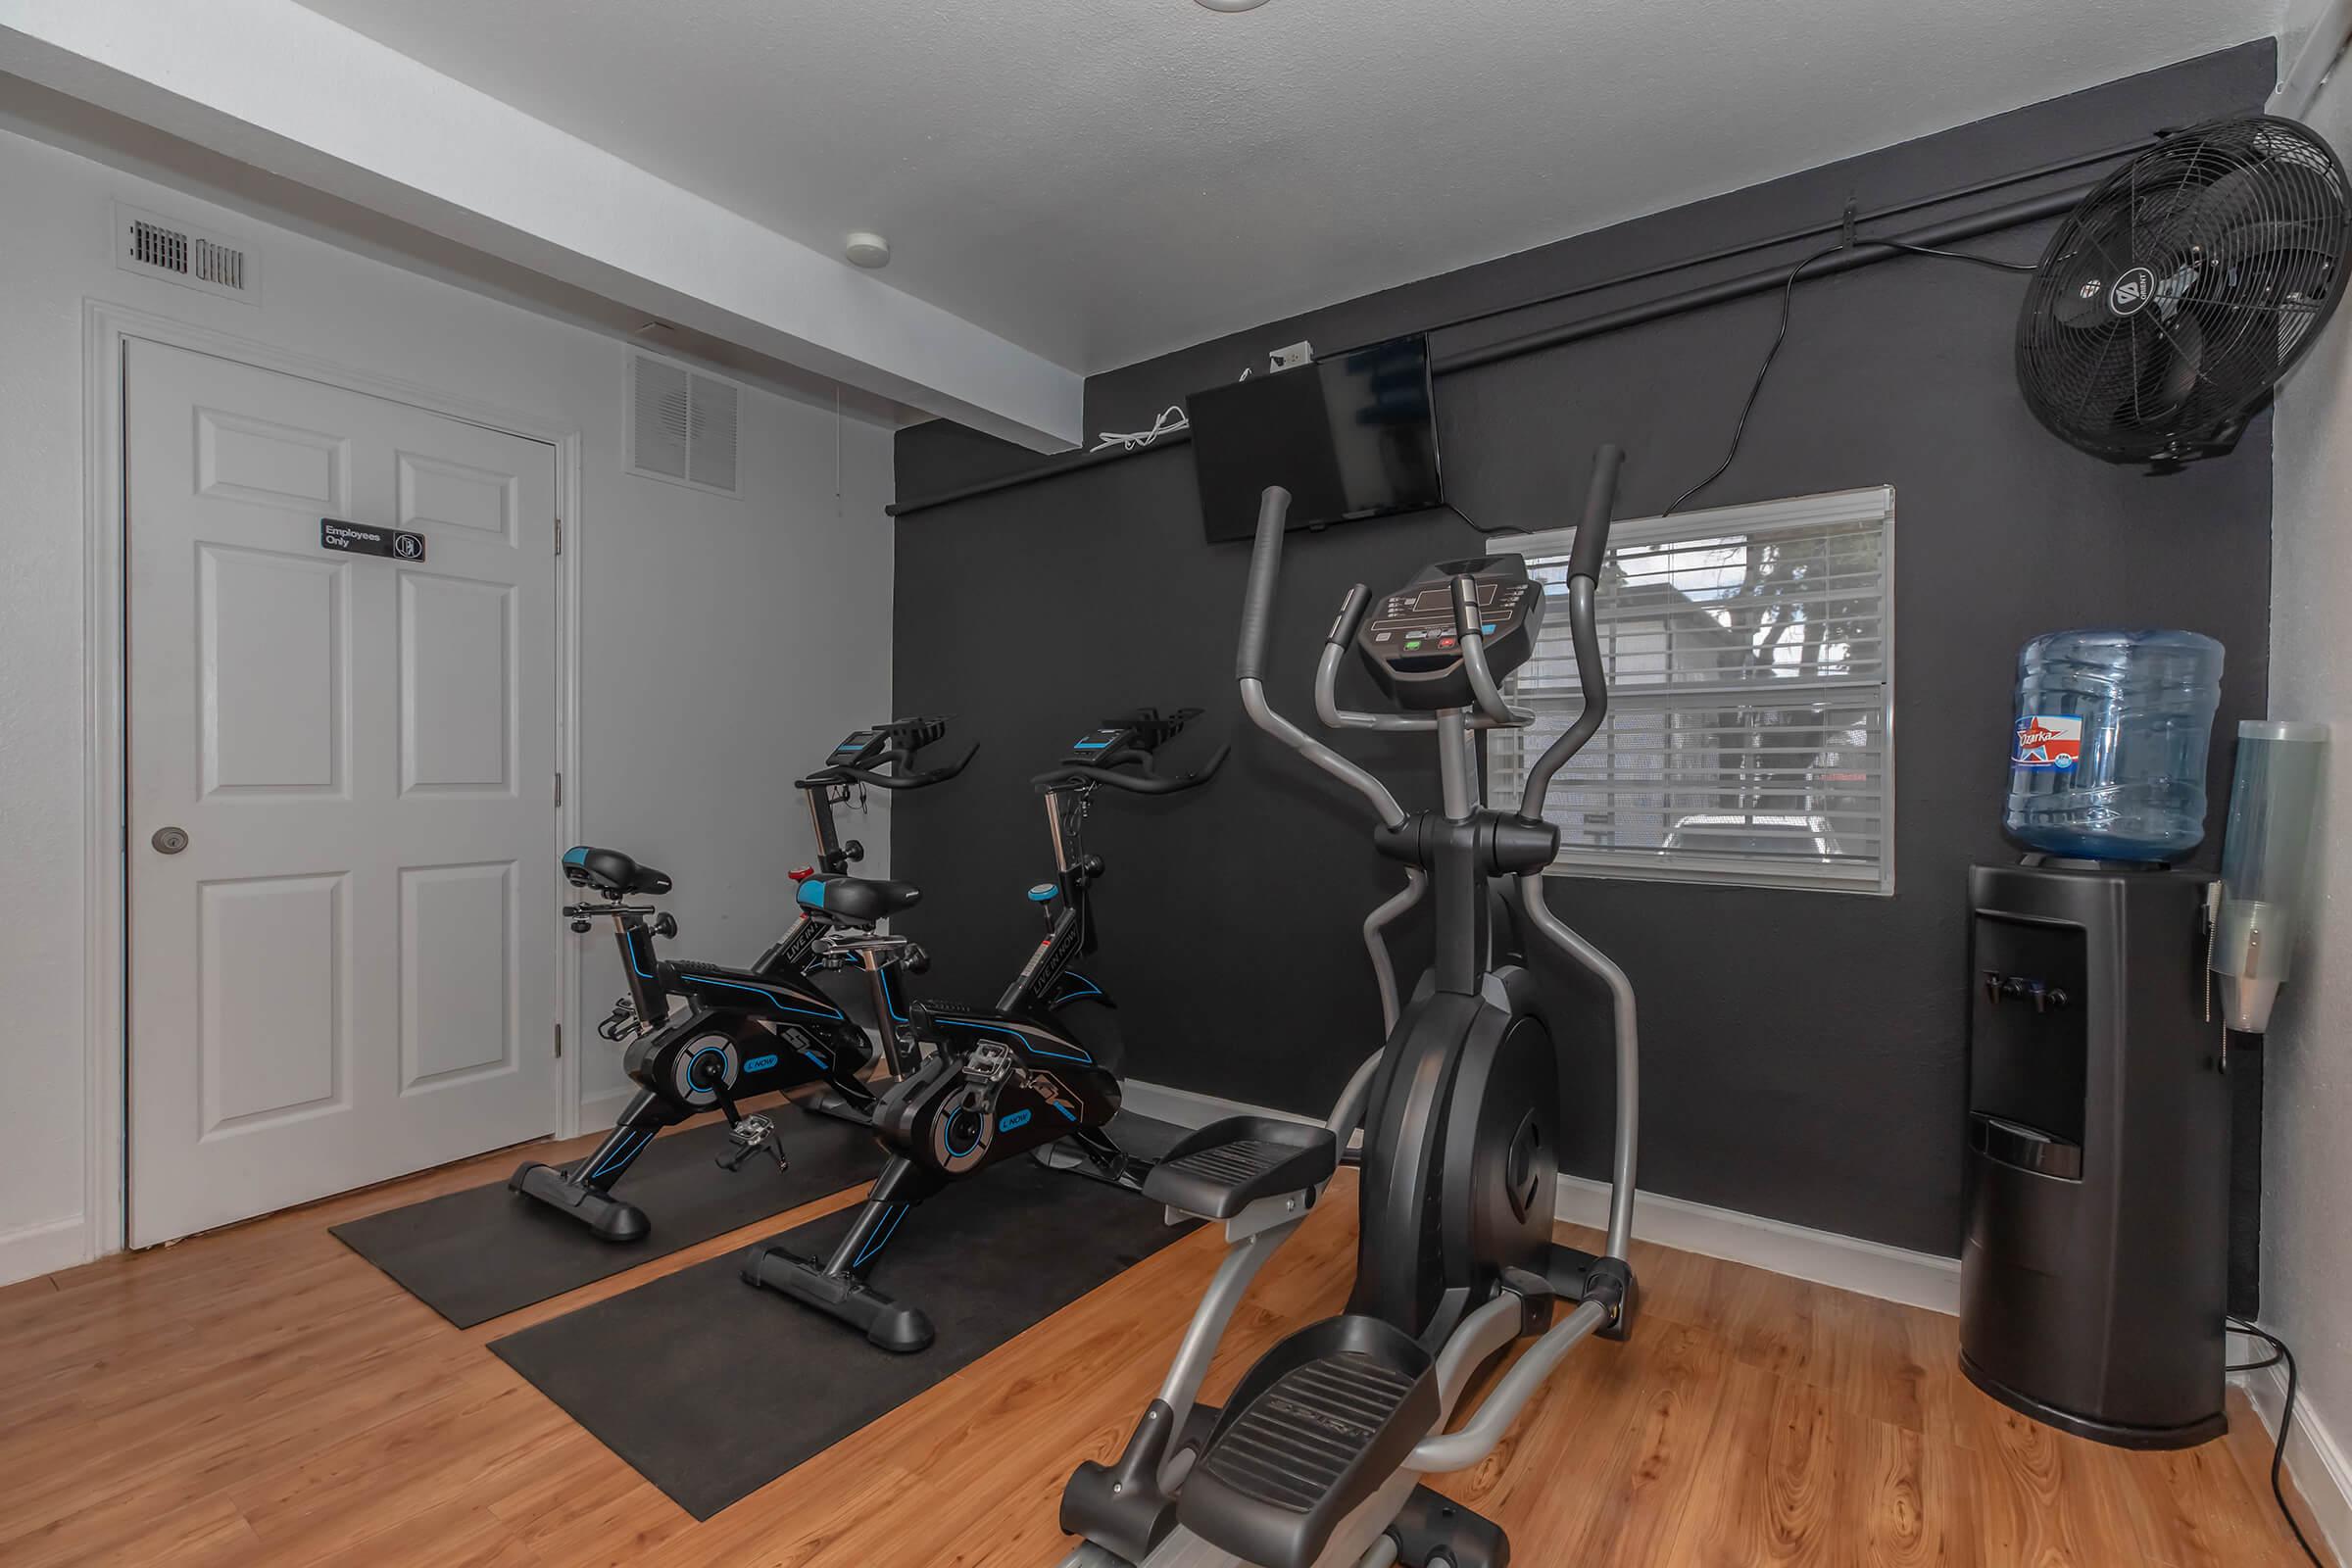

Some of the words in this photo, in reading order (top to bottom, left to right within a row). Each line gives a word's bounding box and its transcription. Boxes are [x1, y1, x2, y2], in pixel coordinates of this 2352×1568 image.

[325, 525, 381, 542] Employees
[325, 535, 350, 549] Only
[2020, 731, 2053, 748] Ozarka
[787, 936, 806, 960] LIVE
[1033, 968, 1051, 995] LIVE
[1058, 929, 1077, 956] NOW
